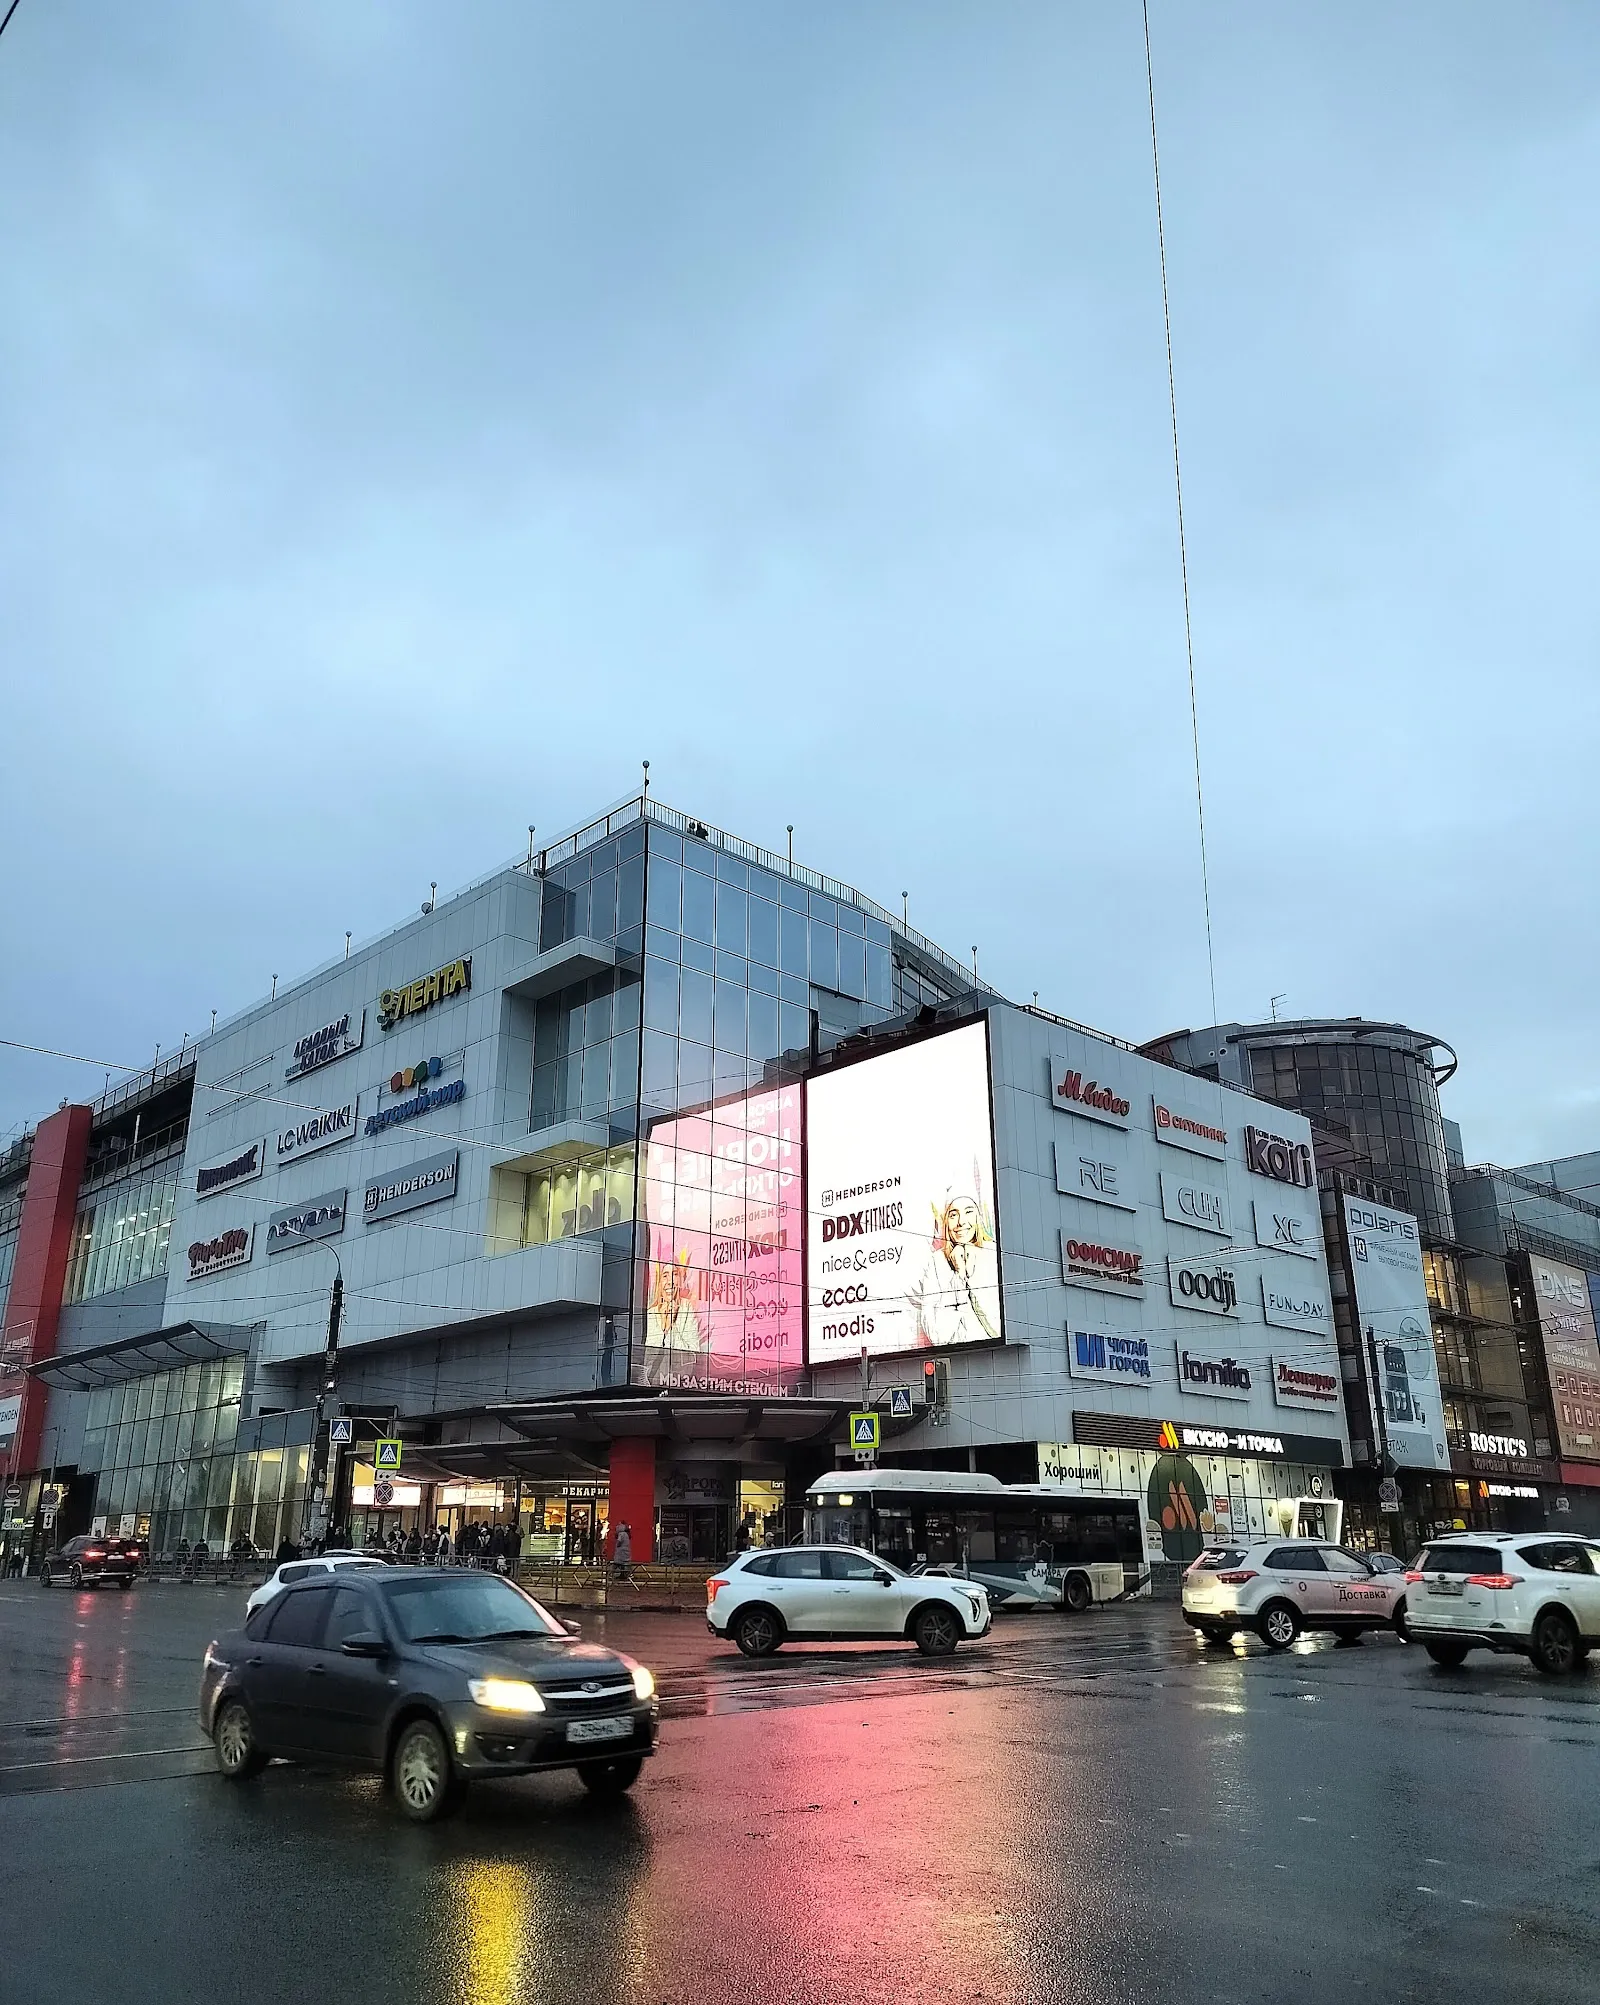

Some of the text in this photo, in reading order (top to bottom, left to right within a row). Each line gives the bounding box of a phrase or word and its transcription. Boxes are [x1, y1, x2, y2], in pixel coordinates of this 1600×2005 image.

[390, 958, 467, 1020] ЛЕНТА
[300, 1039, 339, 1072] КАТОК
[1057, 1069, 1131, 1117] М.видео
[1246, 1125, 1313, 1188] kari
[378, 1163, 455, 1203] HENDERSON
[835, 1176, 901, 1201] HENDERSON
[1078, 1156, 1119, 1195] RE
[1350, 1208, 1415, 1240] polaris
[1066, 1239, 1142, 1270] ОФИСМАГ
[822, 1283, 868, 1308] ecco
[1179, 1266, 1238, 1313] oodji
[1537, 1266, 1587, 1308] DNS
[1269, 1293, 1323, 1317] FUN DAY
[822, 1314, 875, 1340] modis
[1108, 1336, 1149, 1358] ЧИТАЙ
[1108, 1354, 1151, 1378] ГОРОД
[1182, 1351, 1251, 1389] familia
[659, 1372, 788, 1397] МЫ ЗА ЭТИМ СТЕКЛОМ
[1248, 1435, 1284, 1453] ТОЧКА
[1468, 1431, 1528, 1458] ROSTIC'S
[1044, 1461, 1100, 1481] Хороший
[562, 1486, 610, 1497] ПЕКАРНЯ
[1031, 1568, 1061, 1578] САМАРА
[1339, 1589, 1387, 1602] Доставка
